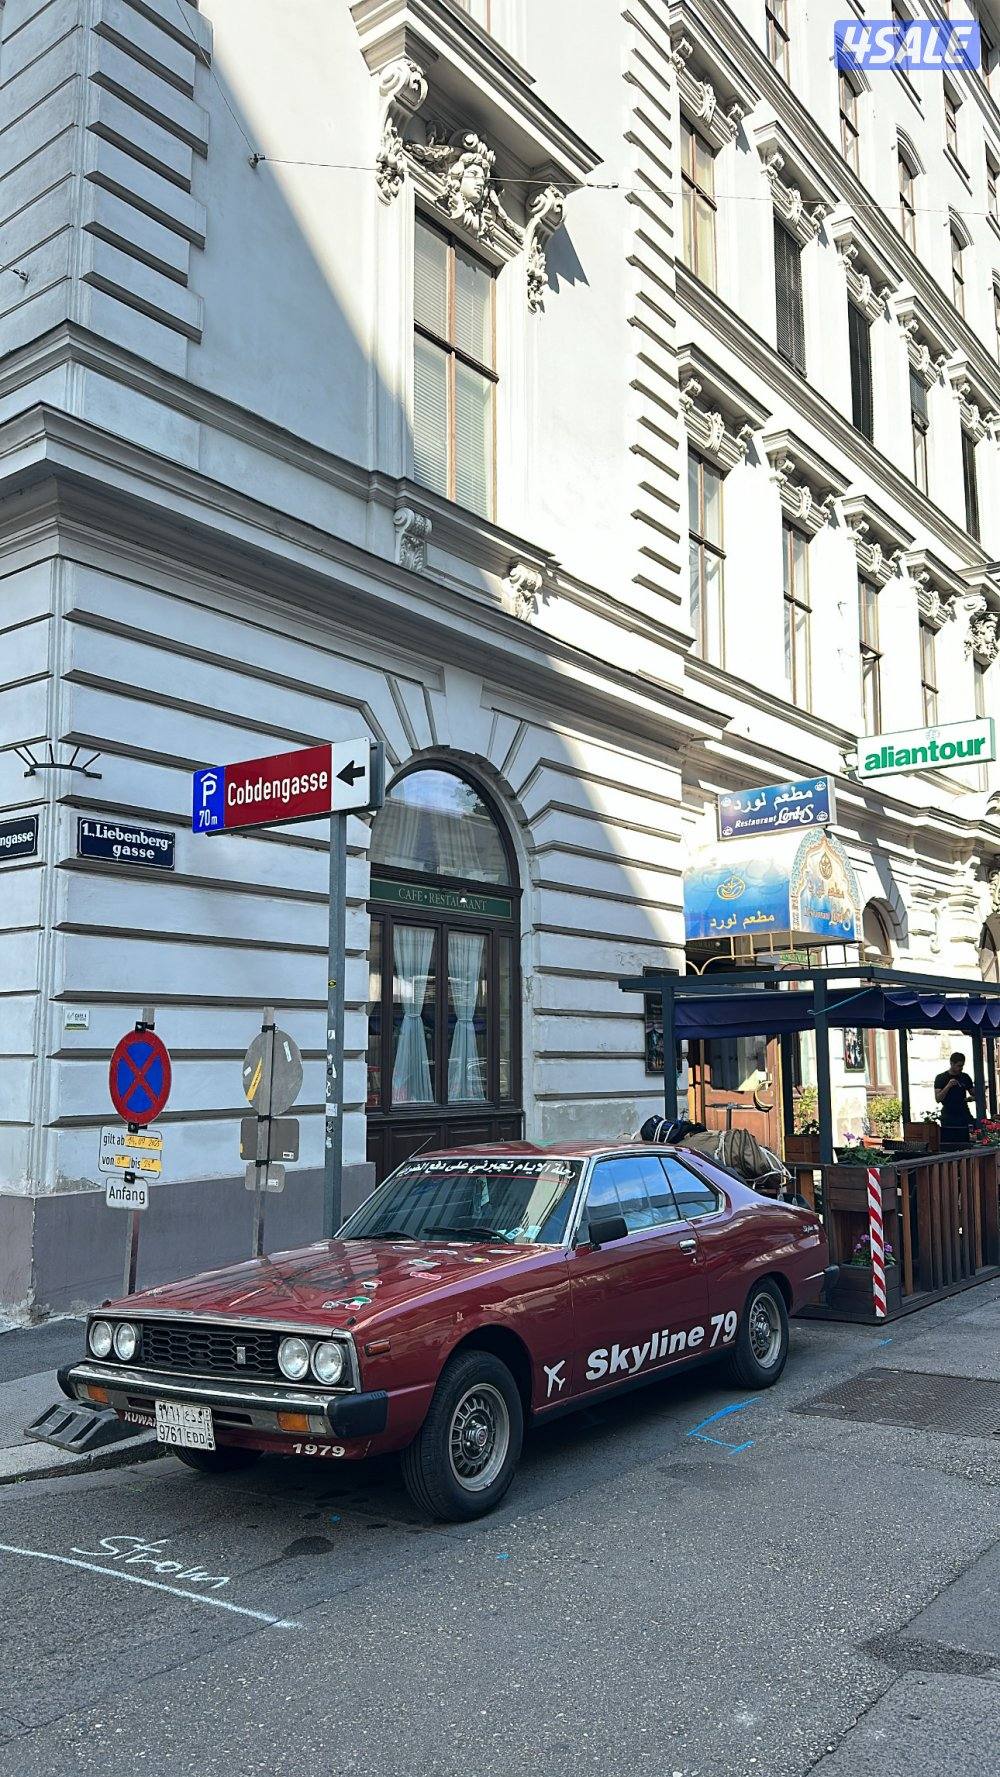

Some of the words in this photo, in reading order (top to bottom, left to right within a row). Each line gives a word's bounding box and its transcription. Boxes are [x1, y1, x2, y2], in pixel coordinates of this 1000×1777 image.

[864, 737, 986, 771] aliantour
[227, 771, 328, 806] Cobdengasse
[733, 792, 767, 813] لورد
[773, 786, 813, 811] مطعم
[735, 814, 777, 829] Restaurant
[112, 844, 155, 859] gasse
[710, 913, 737, 930] لورد
[742, 910, 775, 929] مطعم
[103, 1132, 116, 1146] gilt
[116, 1135, 125, 1146] ab
[102, 1156, 115, 1166] von
[131, 1156, 141, 1170] bis
[108, 1185, 146, 1205] Anfang
[585, 1324, 705, 1381] Skyline
[709, 1310, 738, 1348] 79
[159, 1424, 183, 1443] 9761
[292, 1442, 345, 1457] 1979
